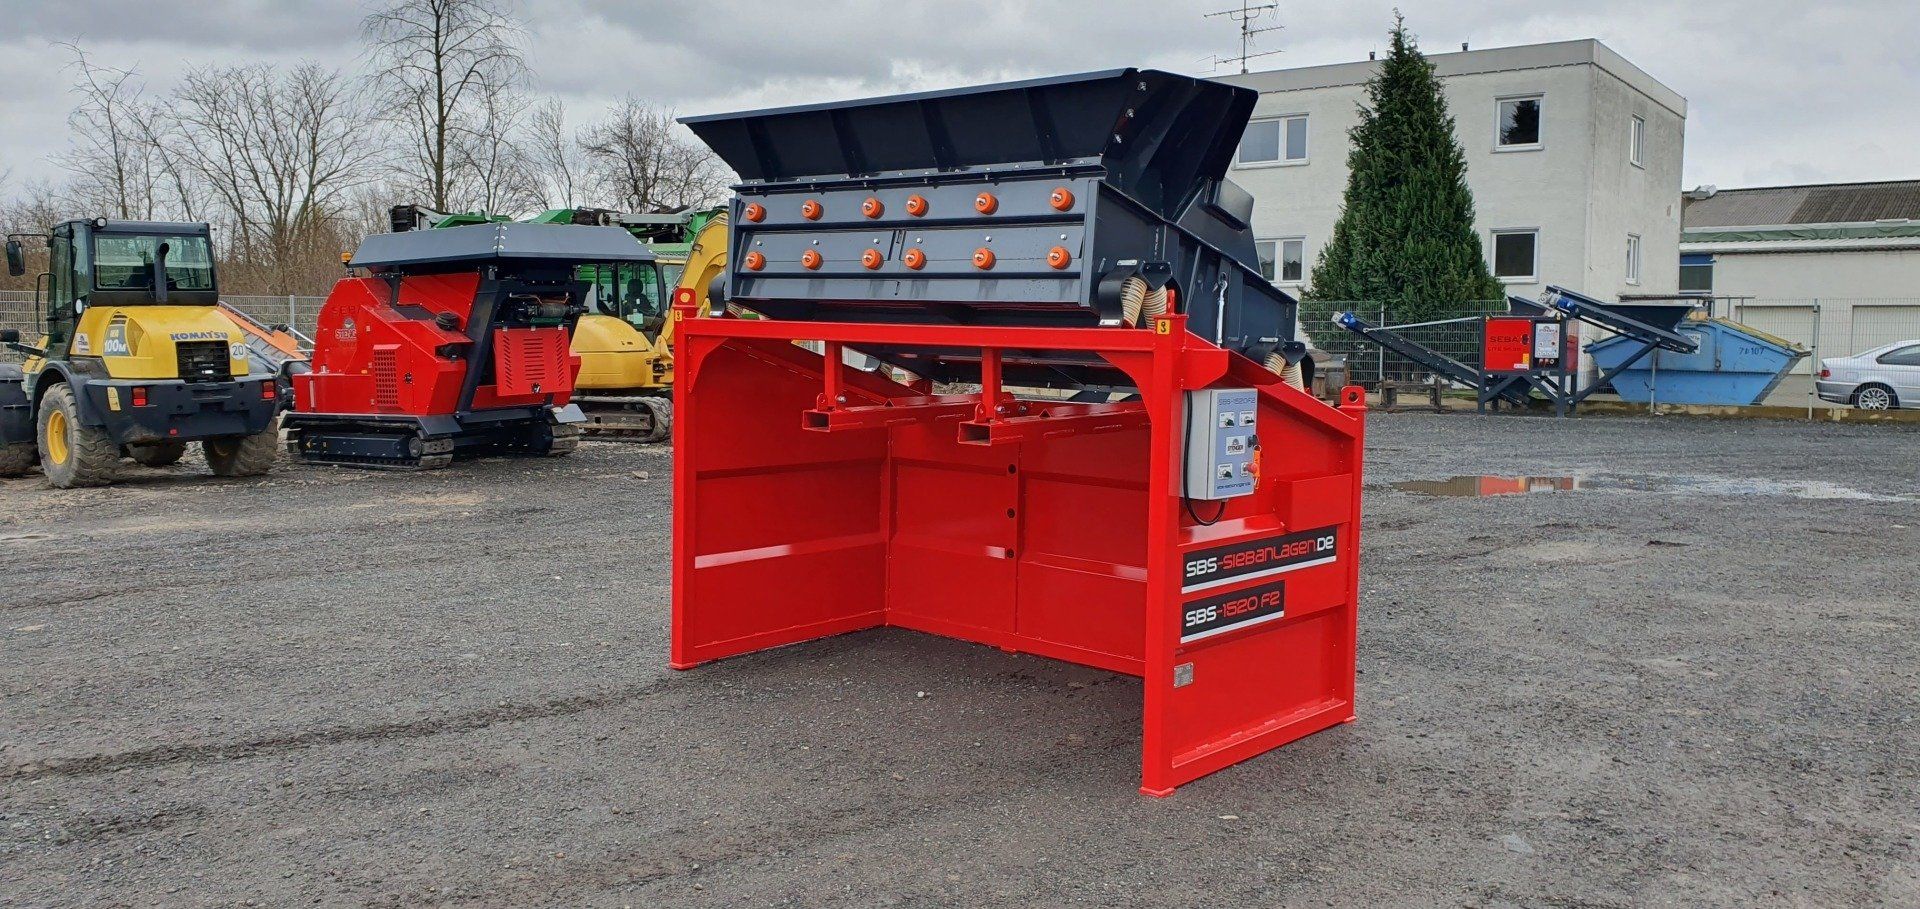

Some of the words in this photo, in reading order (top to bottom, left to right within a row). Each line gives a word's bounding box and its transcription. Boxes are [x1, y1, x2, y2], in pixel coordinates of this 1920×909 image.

[170, 330, 228, 340] KOMATSU
[1490, 335, 1519, 343] SEBA
[232, 345, 243, 356] 20
[1185, 596, 1258, 627] SBS-1520
[1260, 590, 1280, 608] F2
